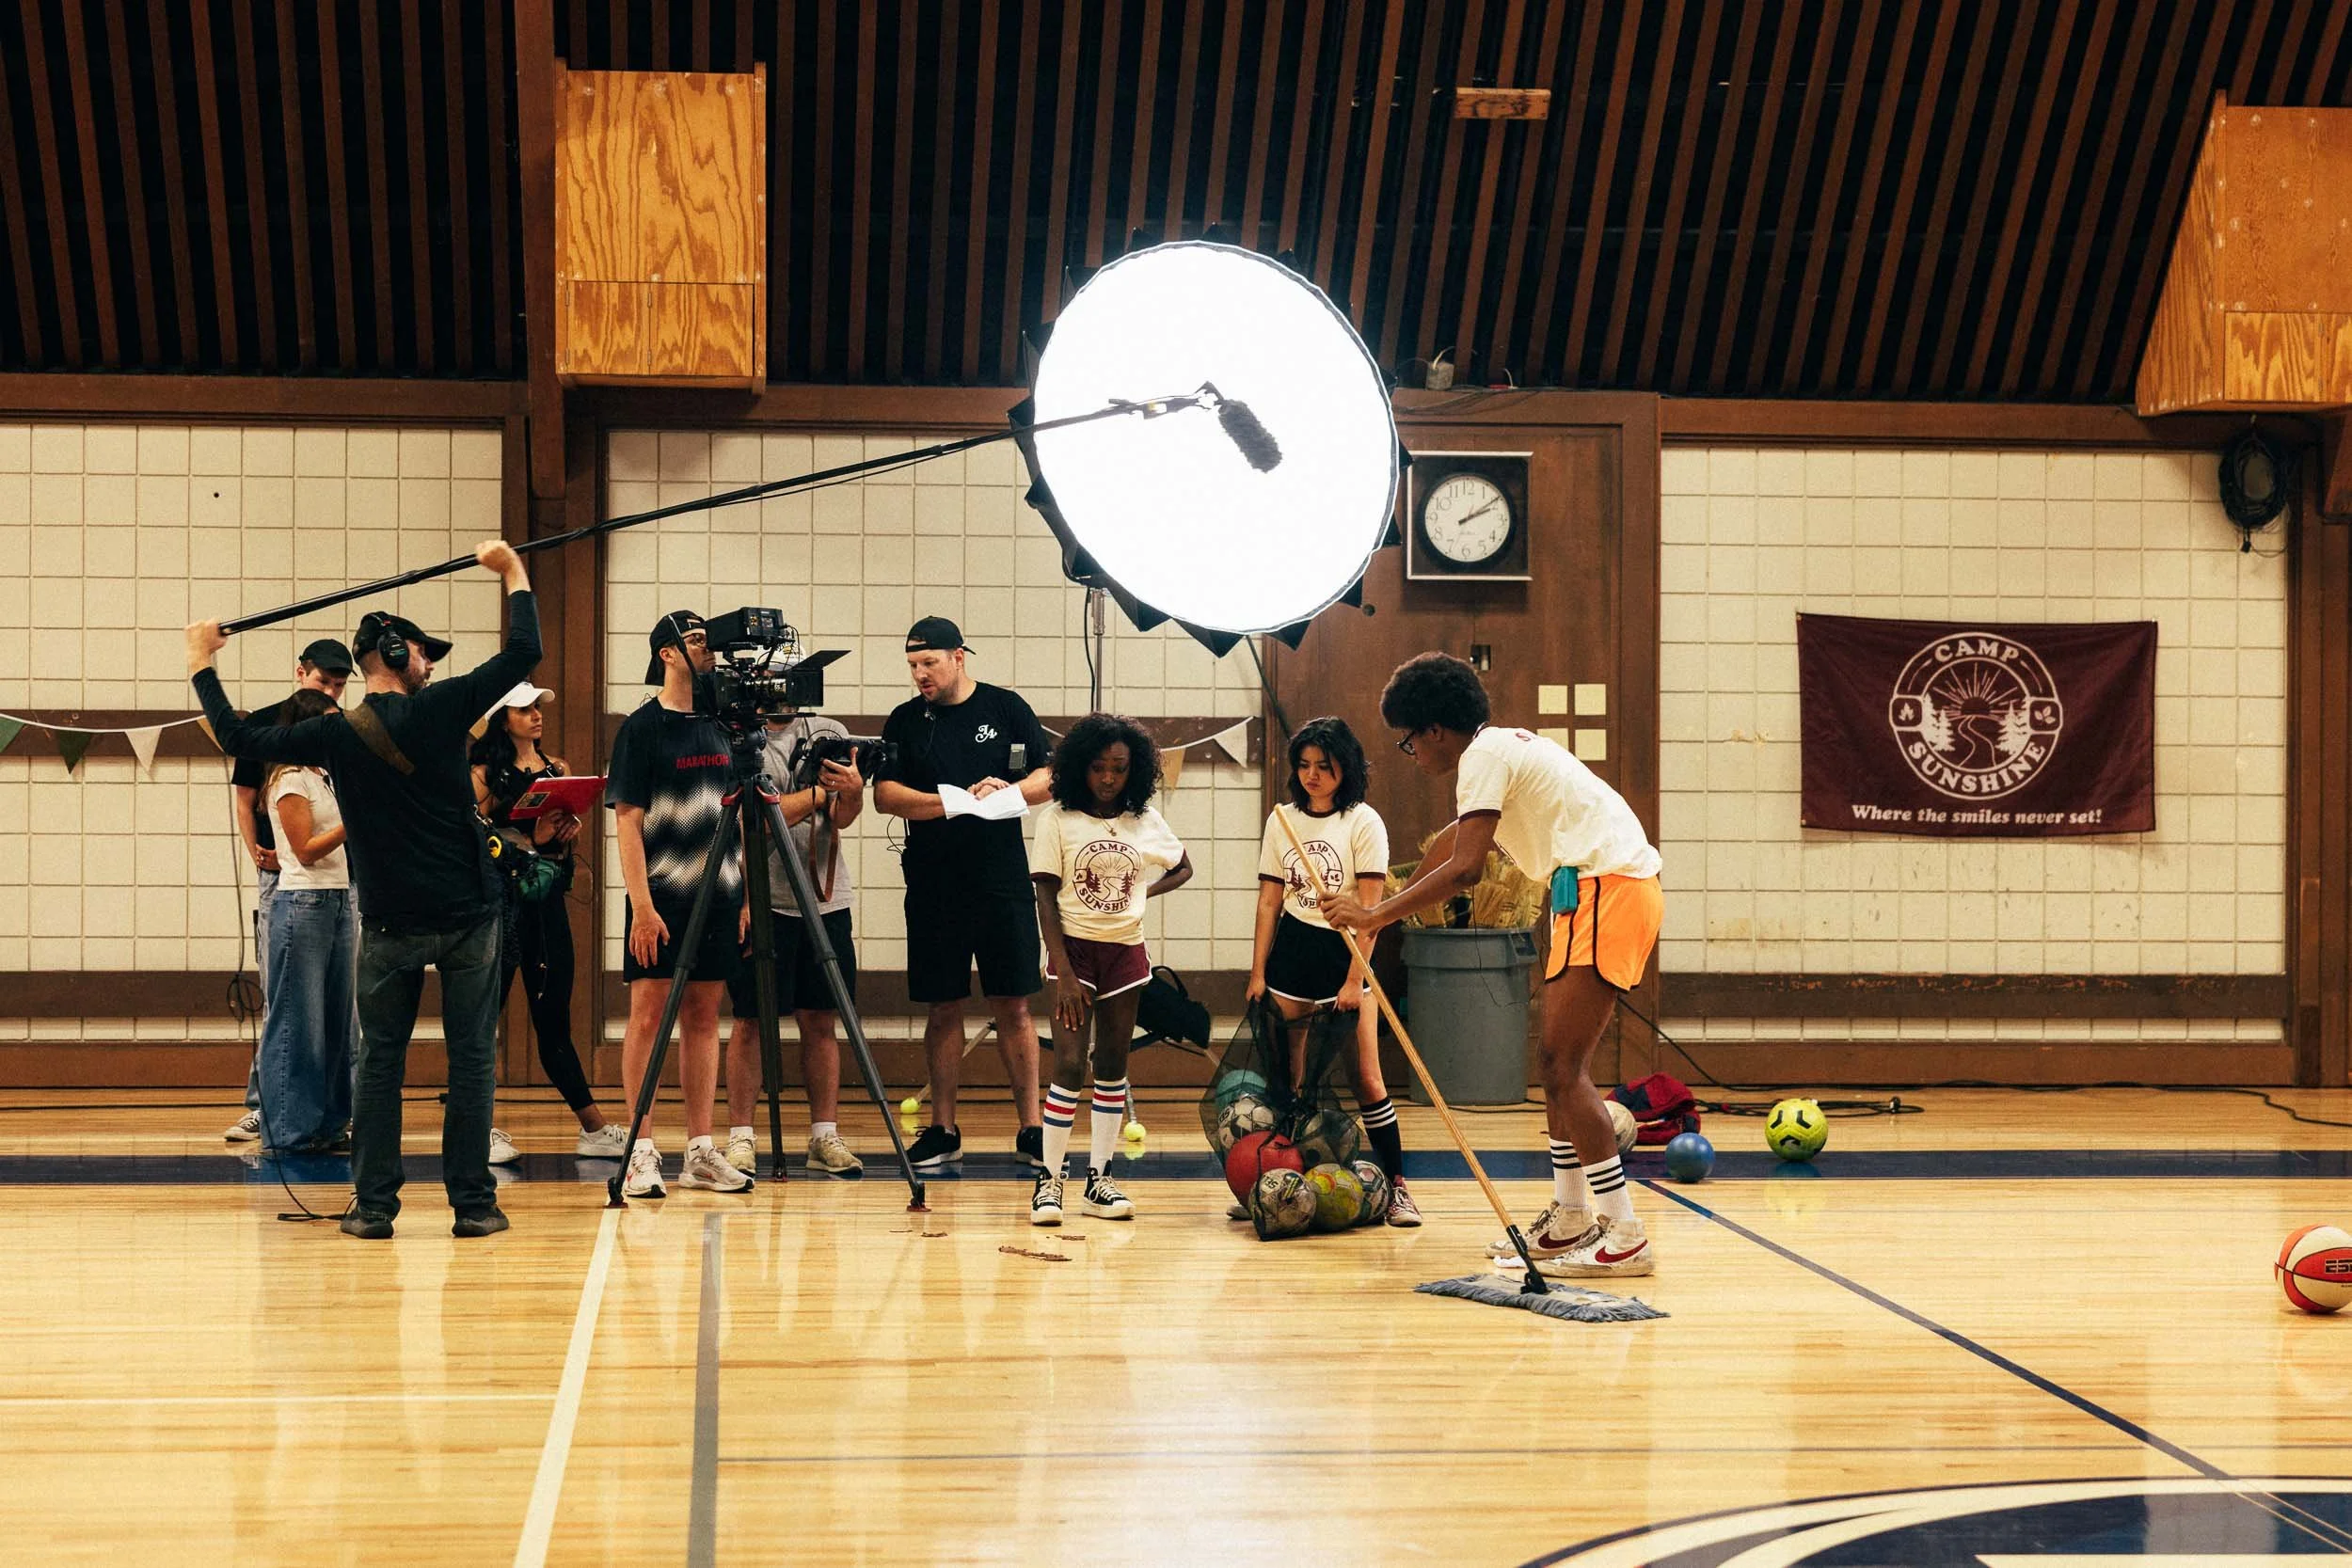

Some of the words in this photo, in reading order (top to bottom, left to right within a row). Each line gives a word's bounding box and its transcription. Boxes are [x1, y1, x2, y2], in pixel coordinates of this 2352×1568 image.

[1449, 484, 1458, 499] 11
[1463, 481, 1475, 496] 12
[1435, 497, 1452, 511] 10
[1429, 511, 1438, 525] 9
[1498, 514, 1505, 527] 3
[1434, 527, 1443, 541] 8
[1488, 530, 1497, 543] 4
[1446, 539, 1454, 553] 7
[1461, 546, 1470, 560] 6
[1477, 540, 1486, 555] 5
[1934, 640, 2019, 662] CAMP
[676, 753, 730, 769] MARATHON
[1908, 741, 2046, 793] SUNSHINE
[1852, 804, 1912, 821] Where
[1917, 808, 1947, 823] the
[1951, 809, 2010, 824] smiles
[2014, 812, 2064, 824] never
[2069, 809, 2102, 824] set!
[1089, 843, 1128, 852] CAMP
[1306, 843, 1328, 853] AMP
[1079, 887, 1129, 911] SUNSHI
